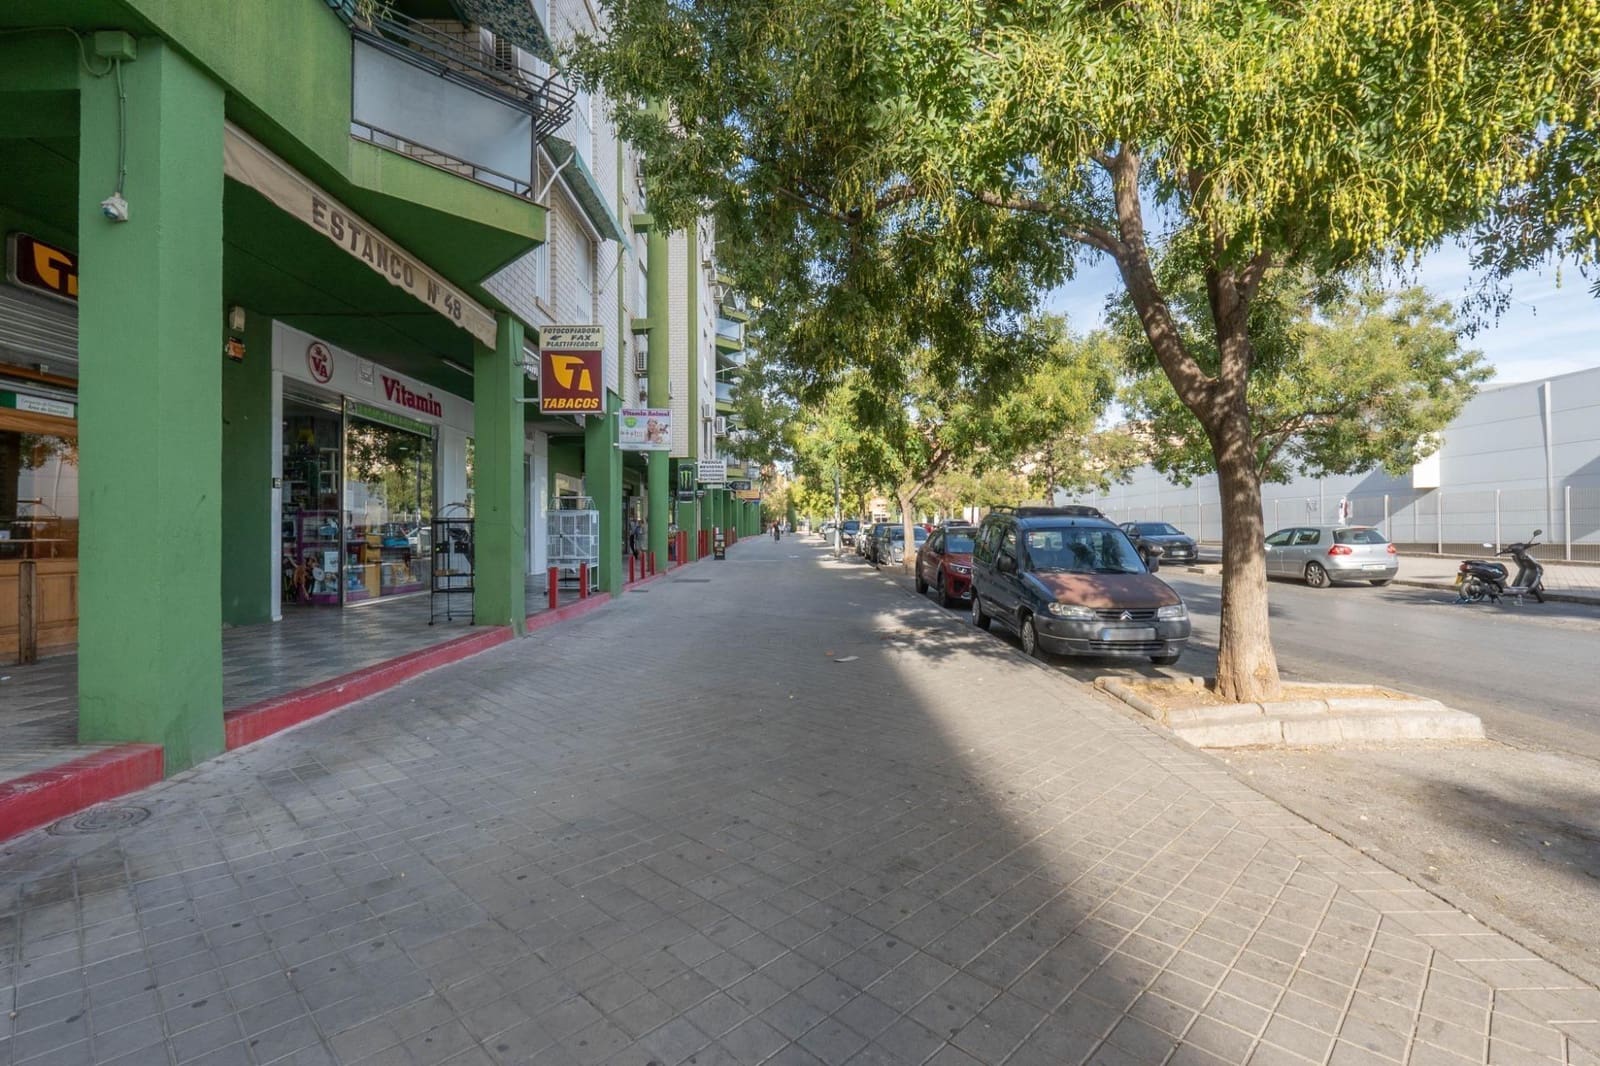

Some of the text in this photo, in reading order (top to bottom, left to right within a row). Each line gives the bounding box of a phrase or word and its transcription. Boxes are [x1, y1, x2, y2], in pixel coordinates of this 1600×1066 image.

[312, 196, 414, 288] ESTANCO
[444, 293, 463, 321] 48
[381, 374, 442, 418] Vitamin
[543, 398, 599, 409] TABACOS
